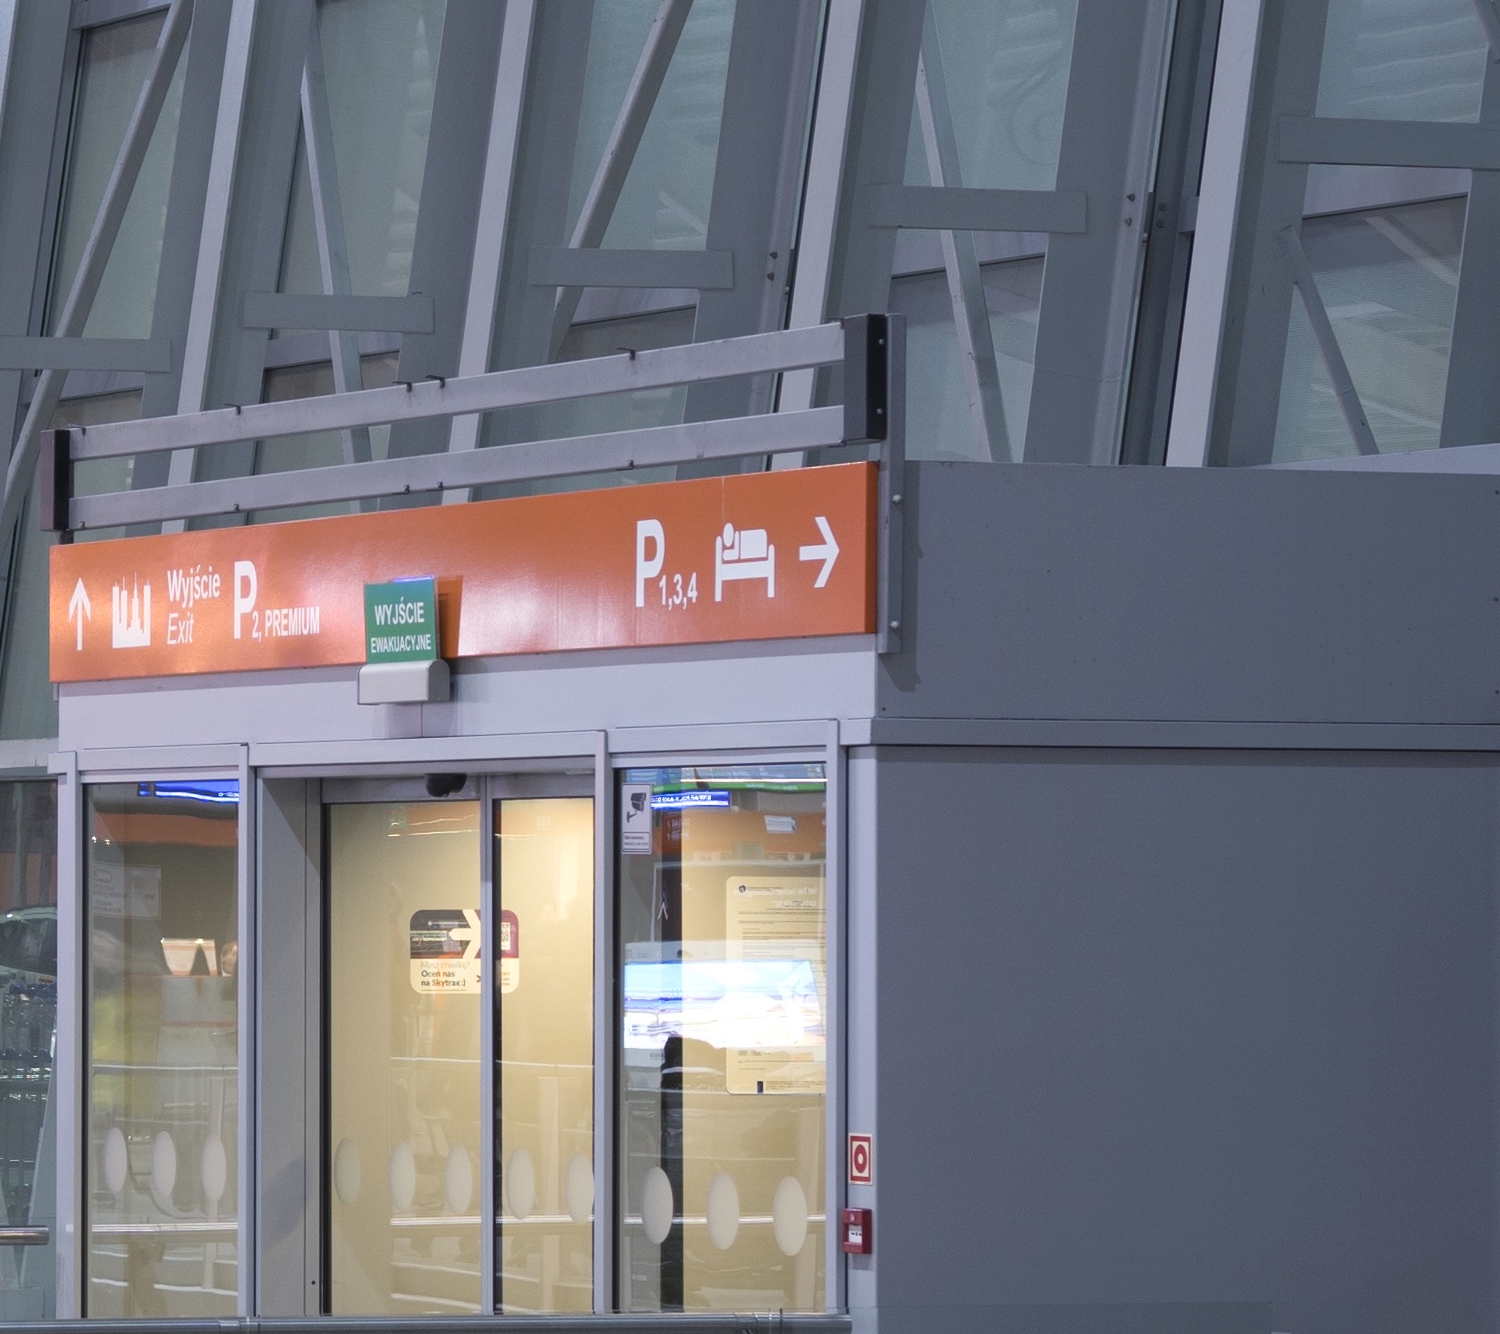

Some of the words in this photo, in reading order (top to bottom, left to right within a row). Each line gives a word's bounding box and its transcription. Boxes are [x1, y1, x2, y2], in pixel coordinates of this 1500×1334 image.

[167, 564, 221, 609] Wyjście
[265, 606, 320, 638] PREMIUM
[374, 596, 425, 626] WYJŚCIE
[167, 612, 195, 645] Exit
[370, 634, 432, 654] EWAKUACYJNE
